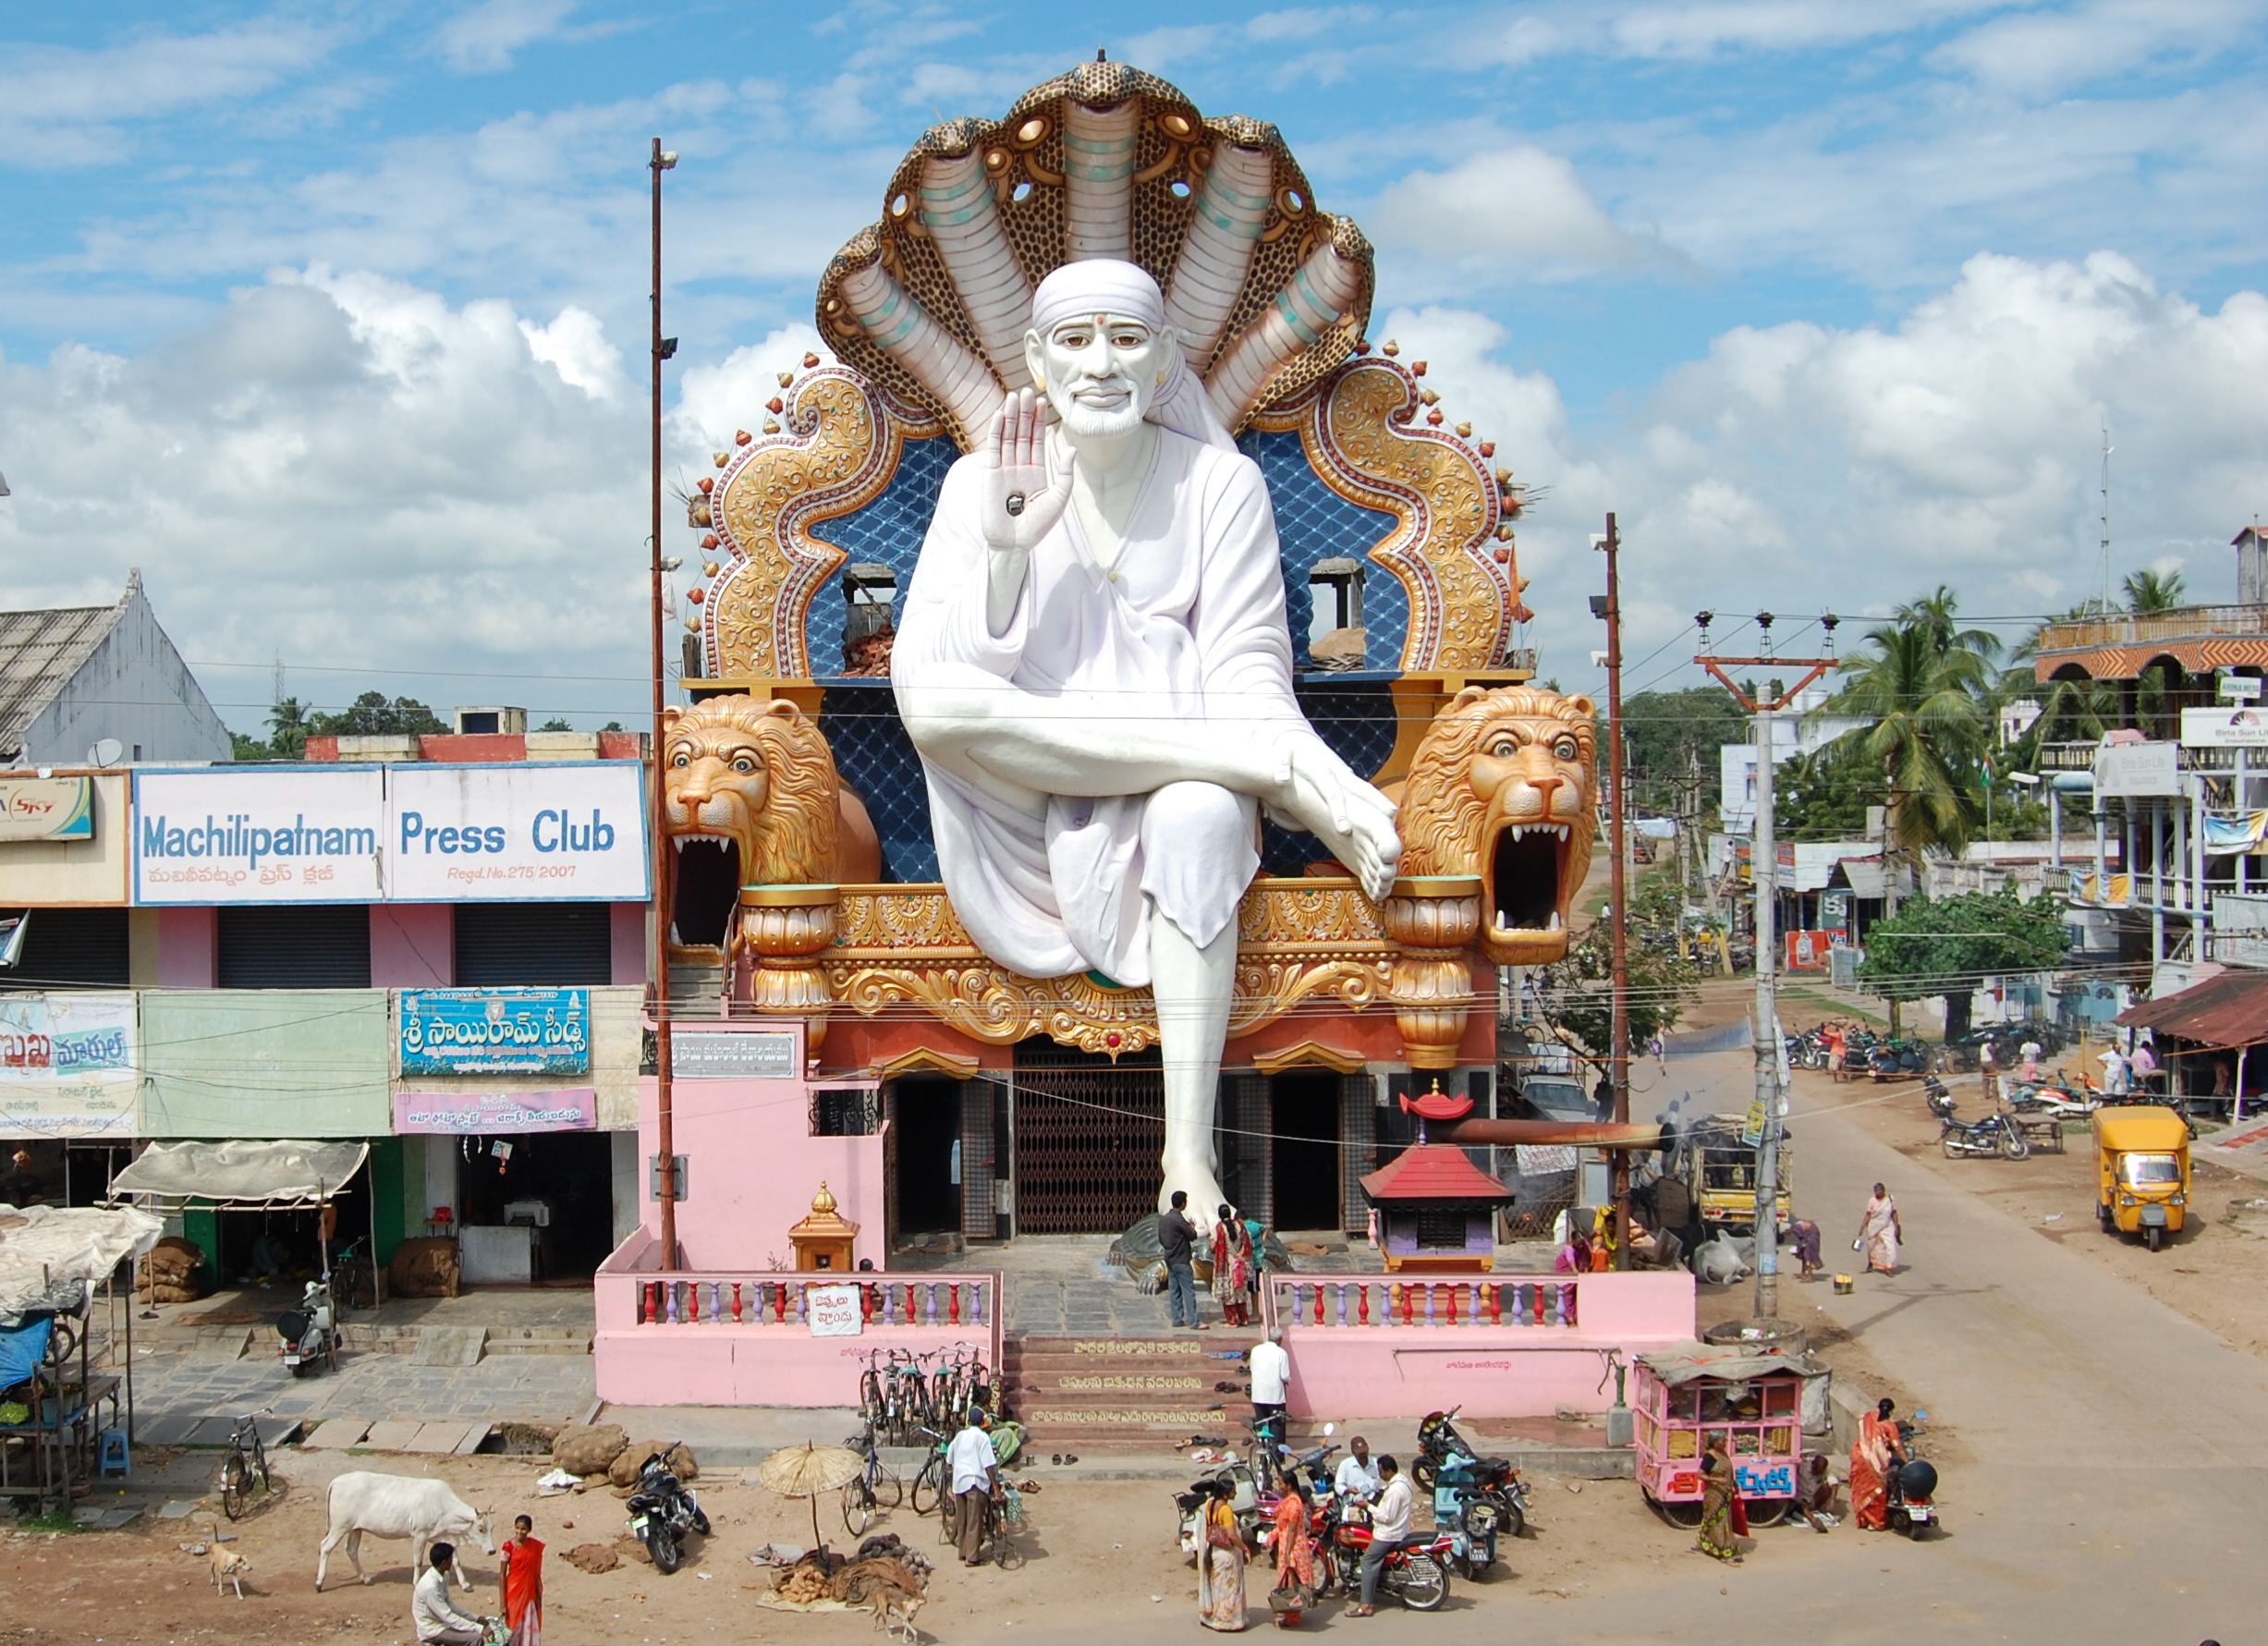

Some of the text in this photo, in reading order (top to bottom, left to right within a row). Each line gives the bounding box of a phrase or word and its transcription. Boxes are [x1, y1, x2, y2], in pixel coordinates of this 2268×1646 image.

[2121, 756, 2165, 769] Birla Sun Life
[143, 809, 615, 871] Machilipatnam Press Club
[258, 863, 292, 884] ప్రెస్
[302, 864, 335, 884] క్లబ్
[402, 1007, 586, 1053] శ్రీ సాయిరామ్ సీడ్స్
[679, 1042, 702, 1062] సాయి
